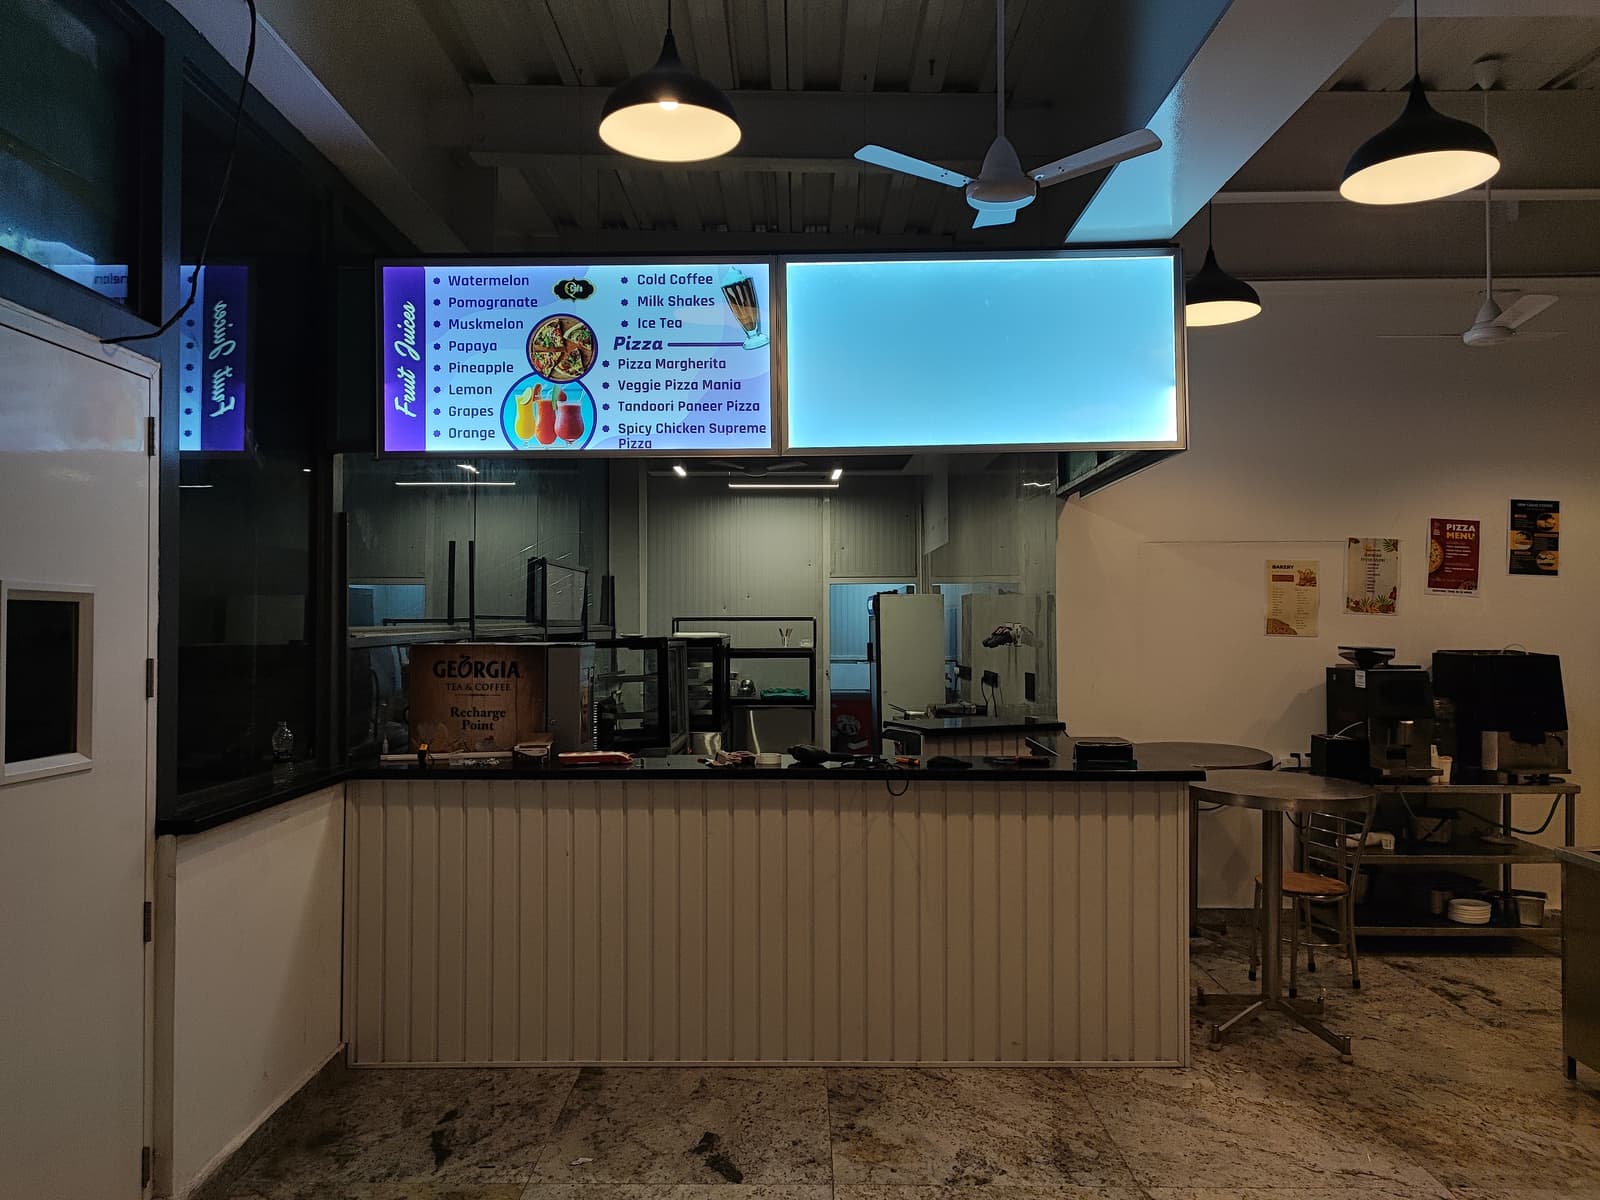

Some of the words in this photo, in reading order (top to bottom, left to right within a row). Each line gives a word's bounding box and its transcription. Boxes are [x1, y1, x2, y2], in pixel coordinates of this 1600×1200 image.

[448, 274, 529, 287] Watermelon
[637, 273, 666, 285] Cold
[670, 273, 713, 285] Coffee
[448, 296, 538, 310] Pomogranate
[637, 295, 664, 307] Milk
[668, 295, 715, 307] Shakes
[448, 318, 524, 330] Muskmelon
[637, 317, 656, 329] Ice
[660, 317, 683, 329] Tea
[394, 300, 421, 361] Juices
[448, 340, 497, 353] Papaya
[613, 336, 663, 351] Pizza
[448, 361, 514, 375] Pineapple
[618, 358, 652, 369] Pizza
[655, 358, 726, 371] Margherita
[394, 365, 417, 418] Fruit
[448, 384, 493, 395] Lemon
[618, 379, 661, 393] Veggie
[665, 379, 699, 391] Pizza
[702, 379, 742, 390] Mania
[448, 405, 494, 419] Grapes
[618, 400, 674, 412] Tandoori
[678, 401, 723, 412] Paneer
[727, 400, 760, 412] Pizza
[448, 427, 496, 441] Orange
[618, 422, 652, 436] Spicy
[655, 422, 706, 434] Chicken
[709, 423, 767, 435] Supreme
[618, 438, 652, 449] Pizza
[1446, 523, 1476, 532] PIZZA
[1446, 532, 1475, 540] MENU
[447, 682, 463, 691] TEA
[475, 682, 512, 691] COFFEE
[450, 706, 506, 721] Recharge
[461, 719, 495, 731] Point
